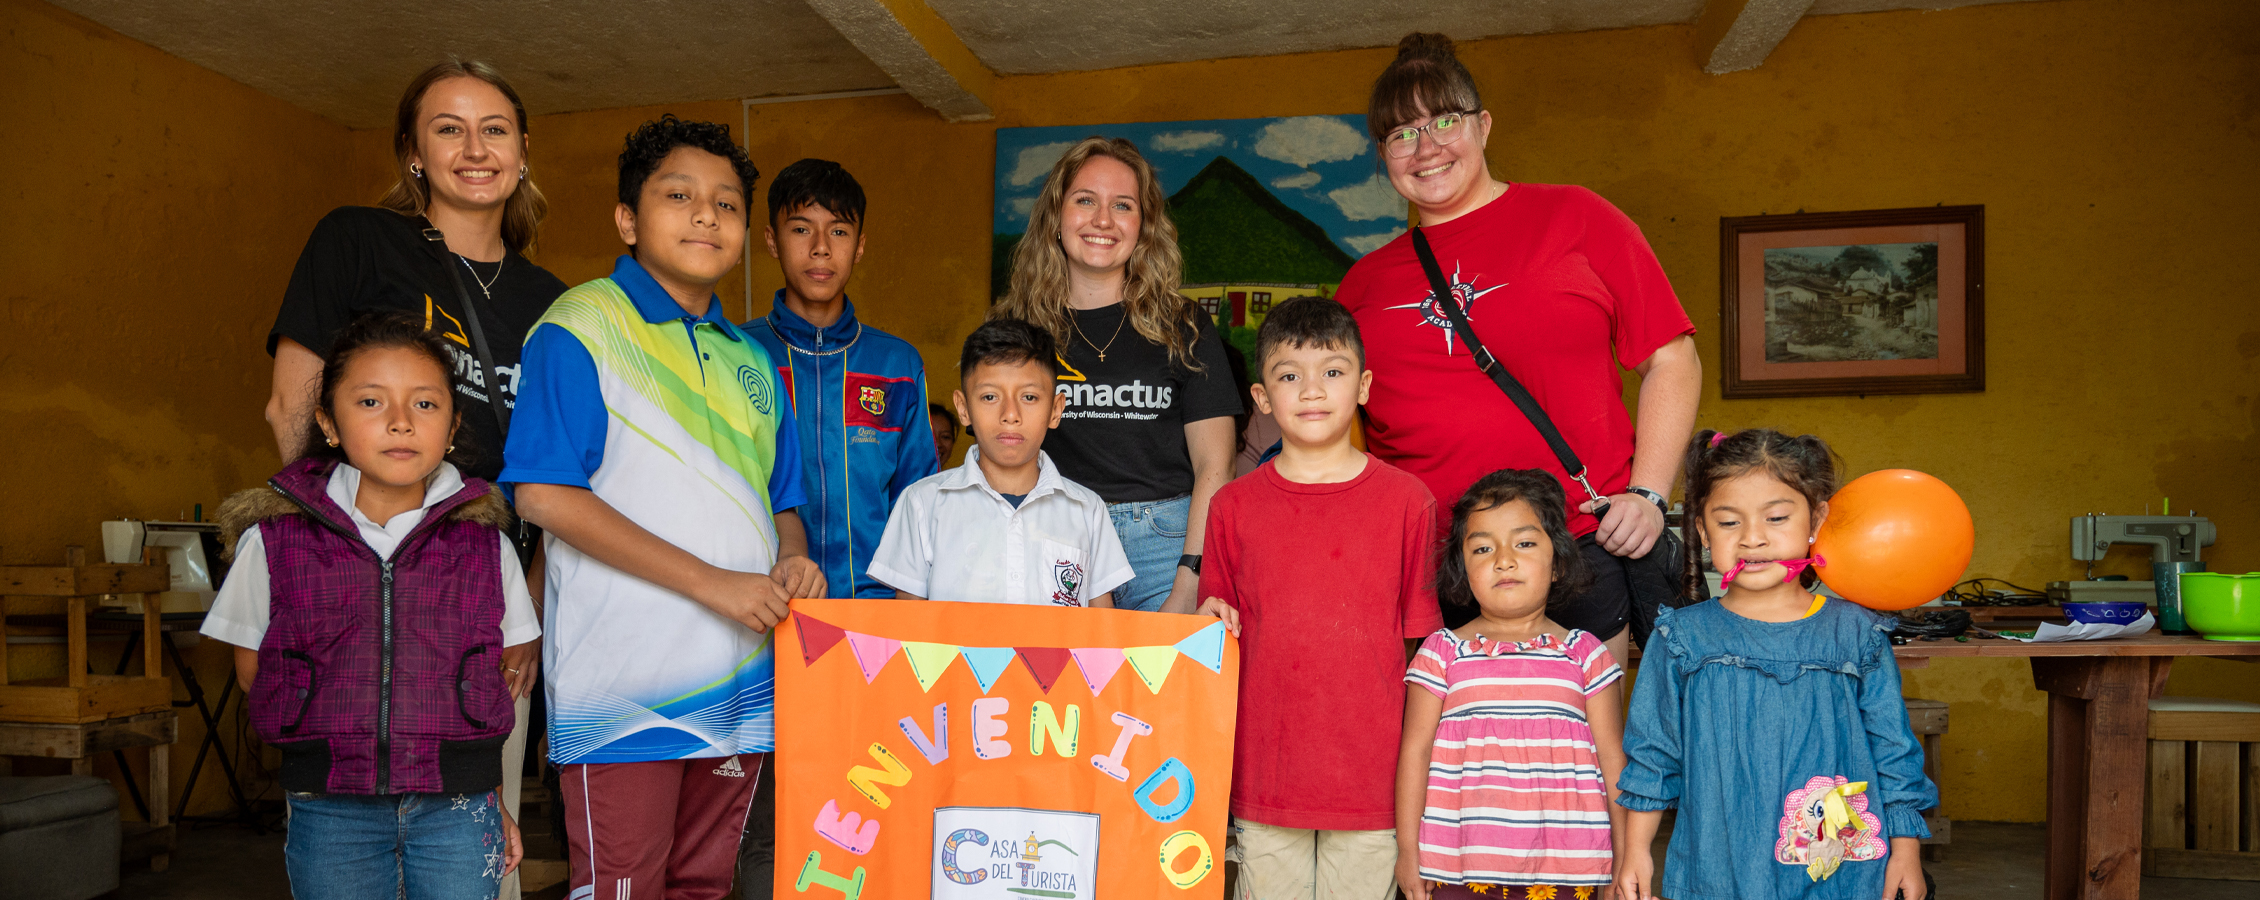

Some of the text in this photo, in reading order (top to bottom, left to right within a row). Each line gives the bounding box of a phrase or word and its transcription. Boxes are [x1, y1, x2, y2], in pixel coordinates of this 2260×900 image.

[461, 385, 490, 404] Wisconsi
[1055, 379, 1173, 409] enactus
[1078, 410, 1088, 419] of
[1087, 411, 1120, 419] Wisconsin
[1124, 412, 1158, 420] Whitewater
[712, 768, 746, 778] adidas
[941, 828, 1019, 885] CASA
[992, 862, 1077, 891] DEL TURISTA
